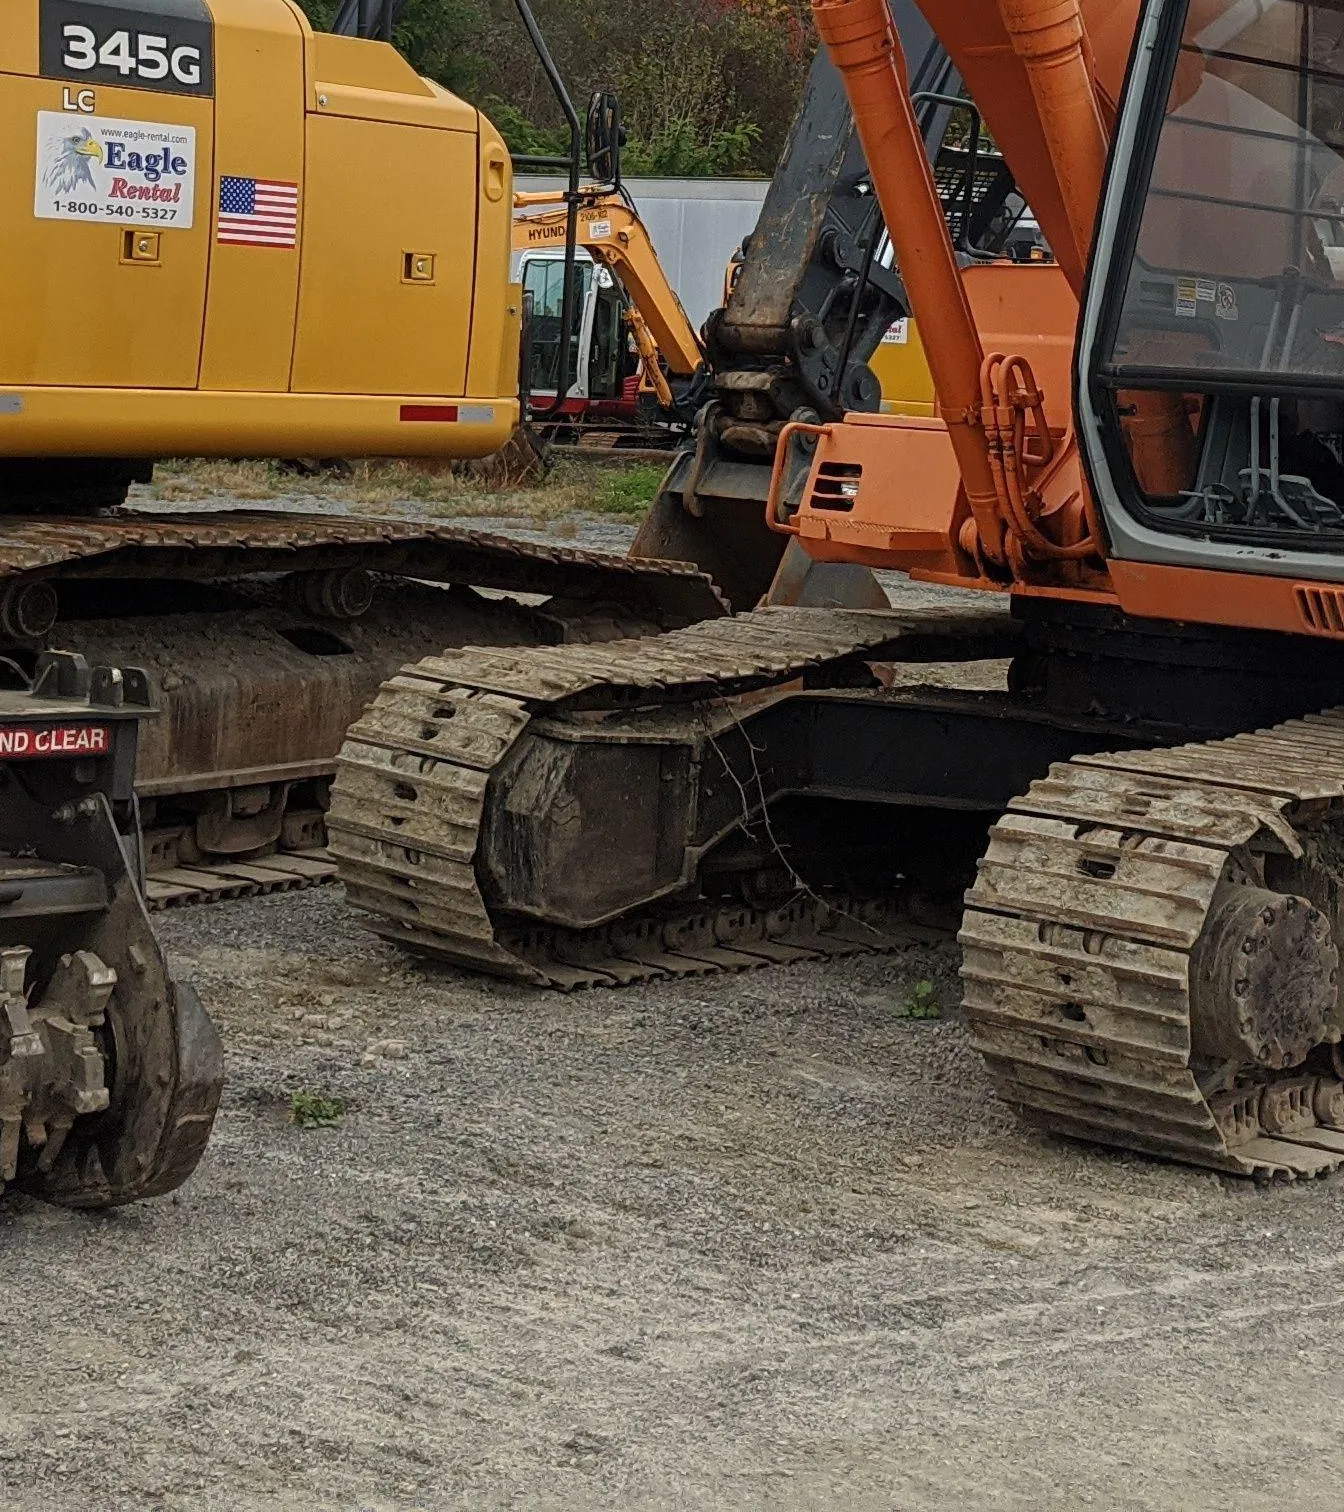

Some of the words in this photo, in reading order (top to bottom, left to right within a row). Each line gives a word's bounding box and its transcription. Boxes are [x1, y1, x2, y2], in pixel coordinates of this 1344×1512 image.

[63, 24, 201, 85] 345G
[62, 87, 96, 112] LC
[101, 127, 188, 144] www.eagle-rental.com
[104, 141, 188, 182] Eagle
[108, 177, 182, 204] Rental
[53, 200, 178, 221] 1-800-540-5327
[528, 225, 565, 240] HYUND
[35, 728, 105, 751] CLEAR
